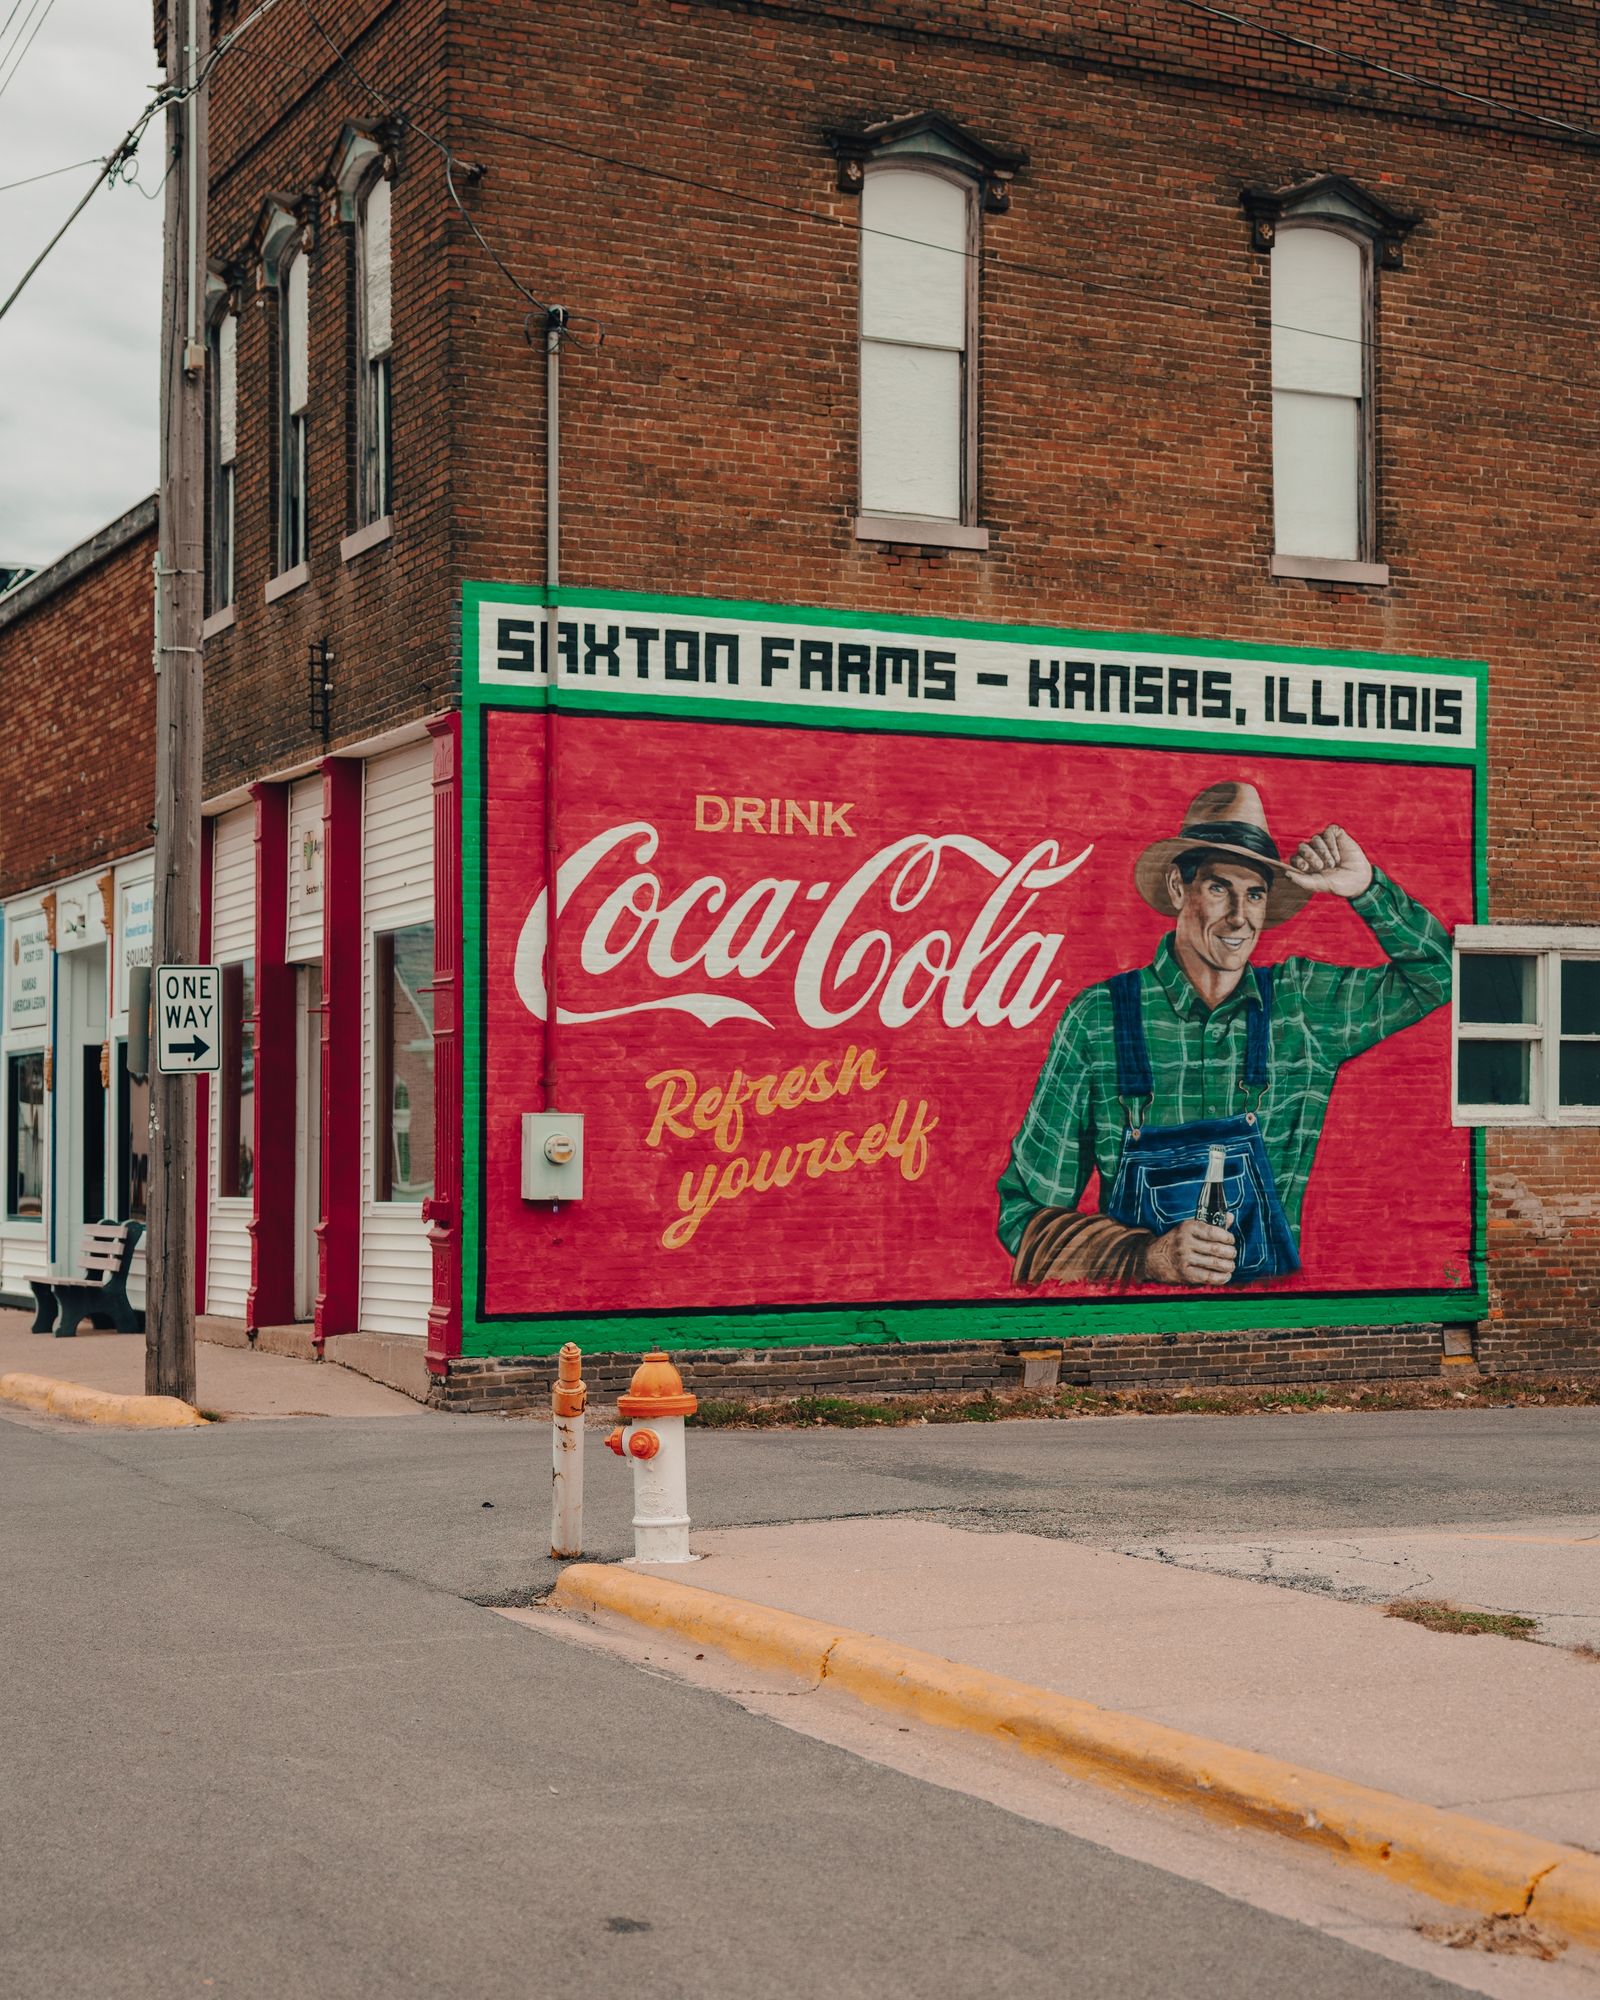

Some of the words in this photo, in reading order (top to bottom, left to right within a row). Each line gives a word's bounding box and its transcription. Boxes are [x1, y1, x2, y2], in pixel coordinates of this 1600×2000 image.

[497, 618, 739, 685] SAXTON
[761, 636, 956, 701] FARMS
[1029, 659, 1246, 726] KANSAS,
[1265, 675, 1462, 735] ILLINOIS
[695, 795, 856, 837] DRINK
[165, 1005, 213, 1029] WAY
[166, 976, 212, 999] ONE
[645, 1045, 887, 1153] Refresh
[661, 1099, 938, 1249] yourself
